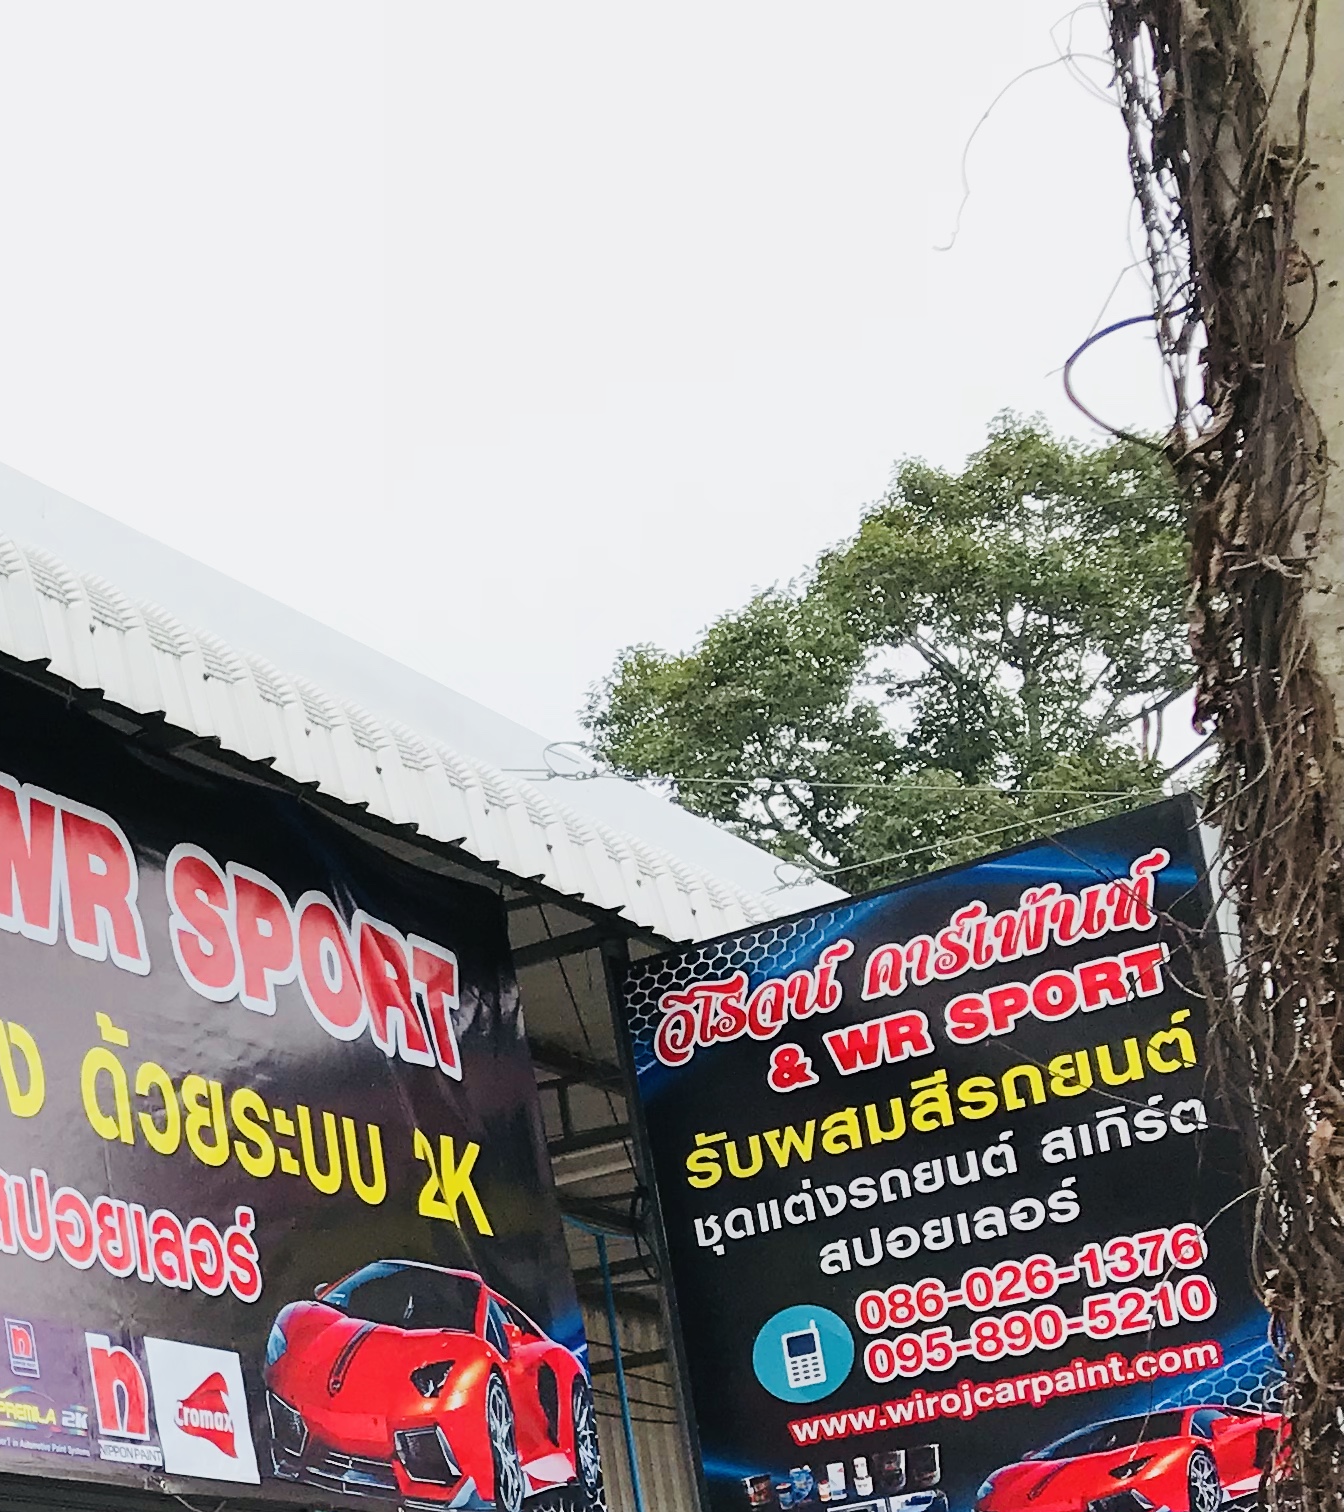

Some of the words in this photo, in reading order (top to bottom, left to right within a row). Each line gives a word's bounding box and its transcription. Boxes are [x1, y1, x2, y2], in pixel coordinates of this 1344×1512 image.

[165, 842, 465, 1082] SPORT
[767, 1041, 820, 1093] &
[824, 1010, 935, 1077] WR
[945, 943, 1171, 1045] SPORT
[80, 1012, 388, 1206] ด้วยระบบ
[414, 1125, 494, 1238] 2K
[684, 1009, 1201, 1190] รับผสมสีรถยนต์
[694, 1130, 1019, 1256] ชุดแต่งรถยนต์
[1040, 1093, 1209, 1167] สเกิร์ต
[818, 1177, 1082, 1276] สปอยเลอร์
[855, 1222, 1208, 1336] 086-026-1376
[863, 1273, 1218, 1384] 095-890-5210
[61, 1409, 88, 1430] 2K
[174, 1401, 234, 1434] Cromax
[788, 1341, 1223, 1447] www.wirojcarpaint.com
